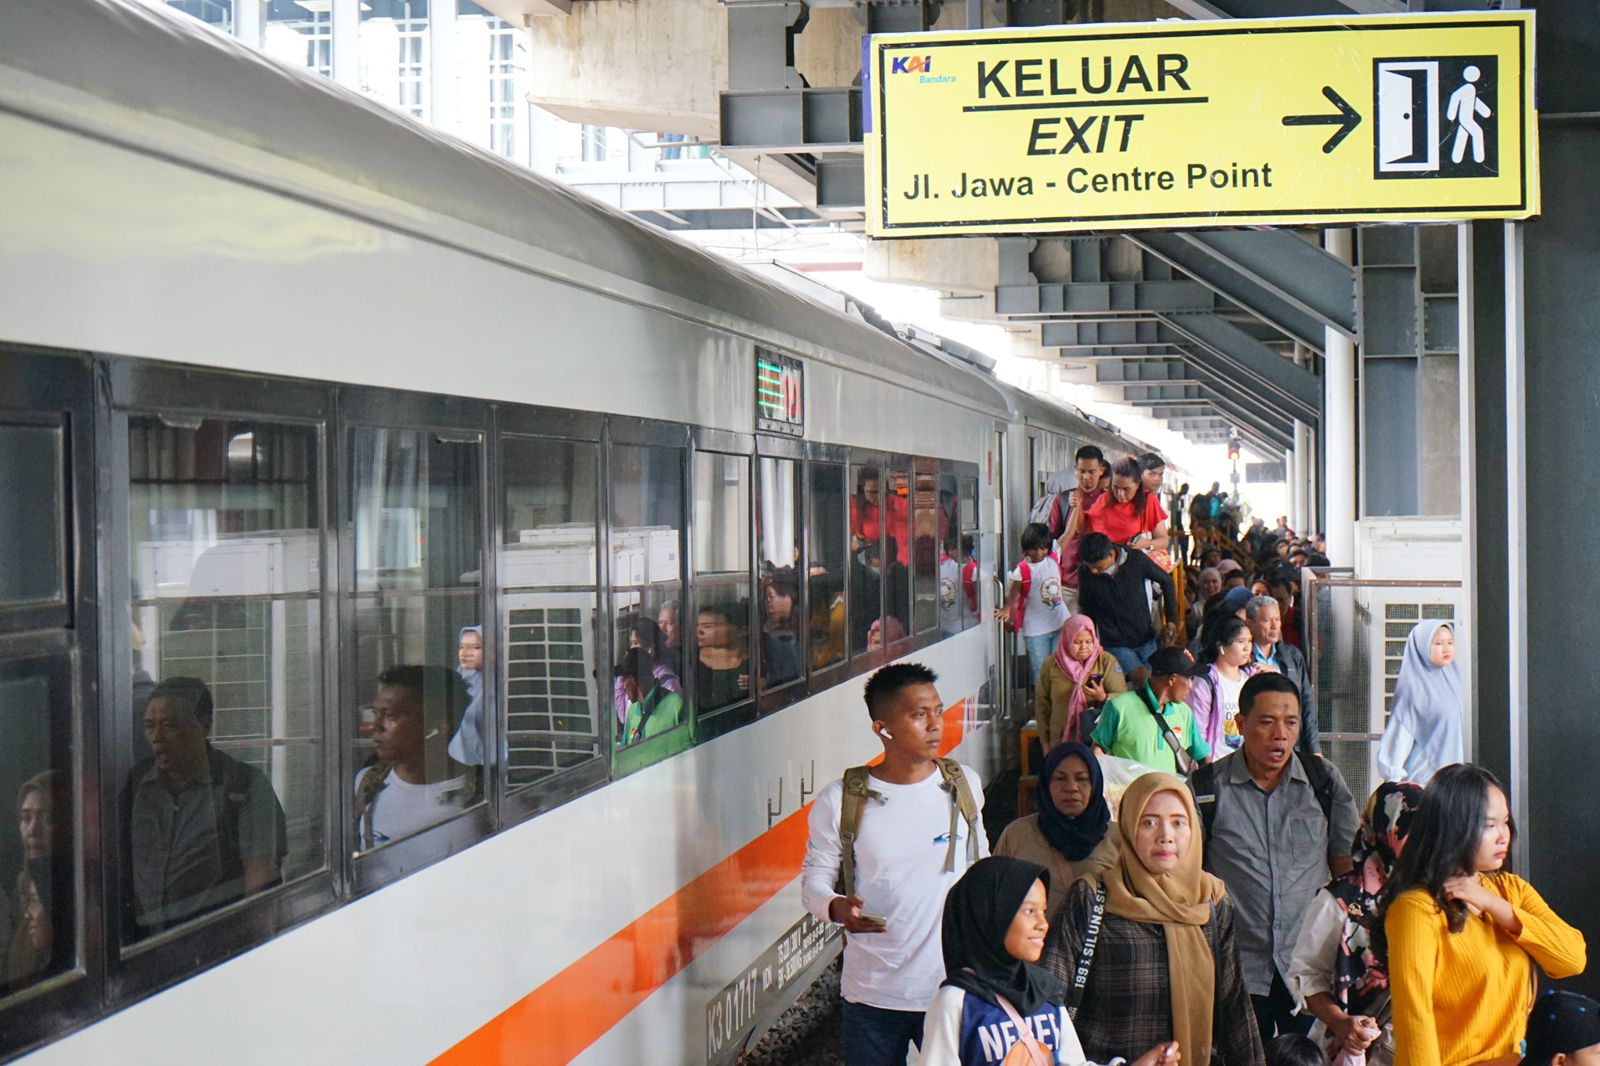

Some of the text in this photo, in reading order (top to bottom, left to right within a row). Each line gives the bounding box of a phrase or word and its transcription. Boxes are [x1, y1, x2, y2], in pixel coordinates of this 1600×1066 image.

[892, 55, 931, 74] KAI
[919, 75, 956, 83] Bandara
[977, 53, 1192, 99] KELUAR
[1026, 114, 1145, 156] EXIT
[951, 172, 1034, 199] Jawa
[1066, 166, 1175, 194] Centre
[1187, 162, 1273, 189] Point
